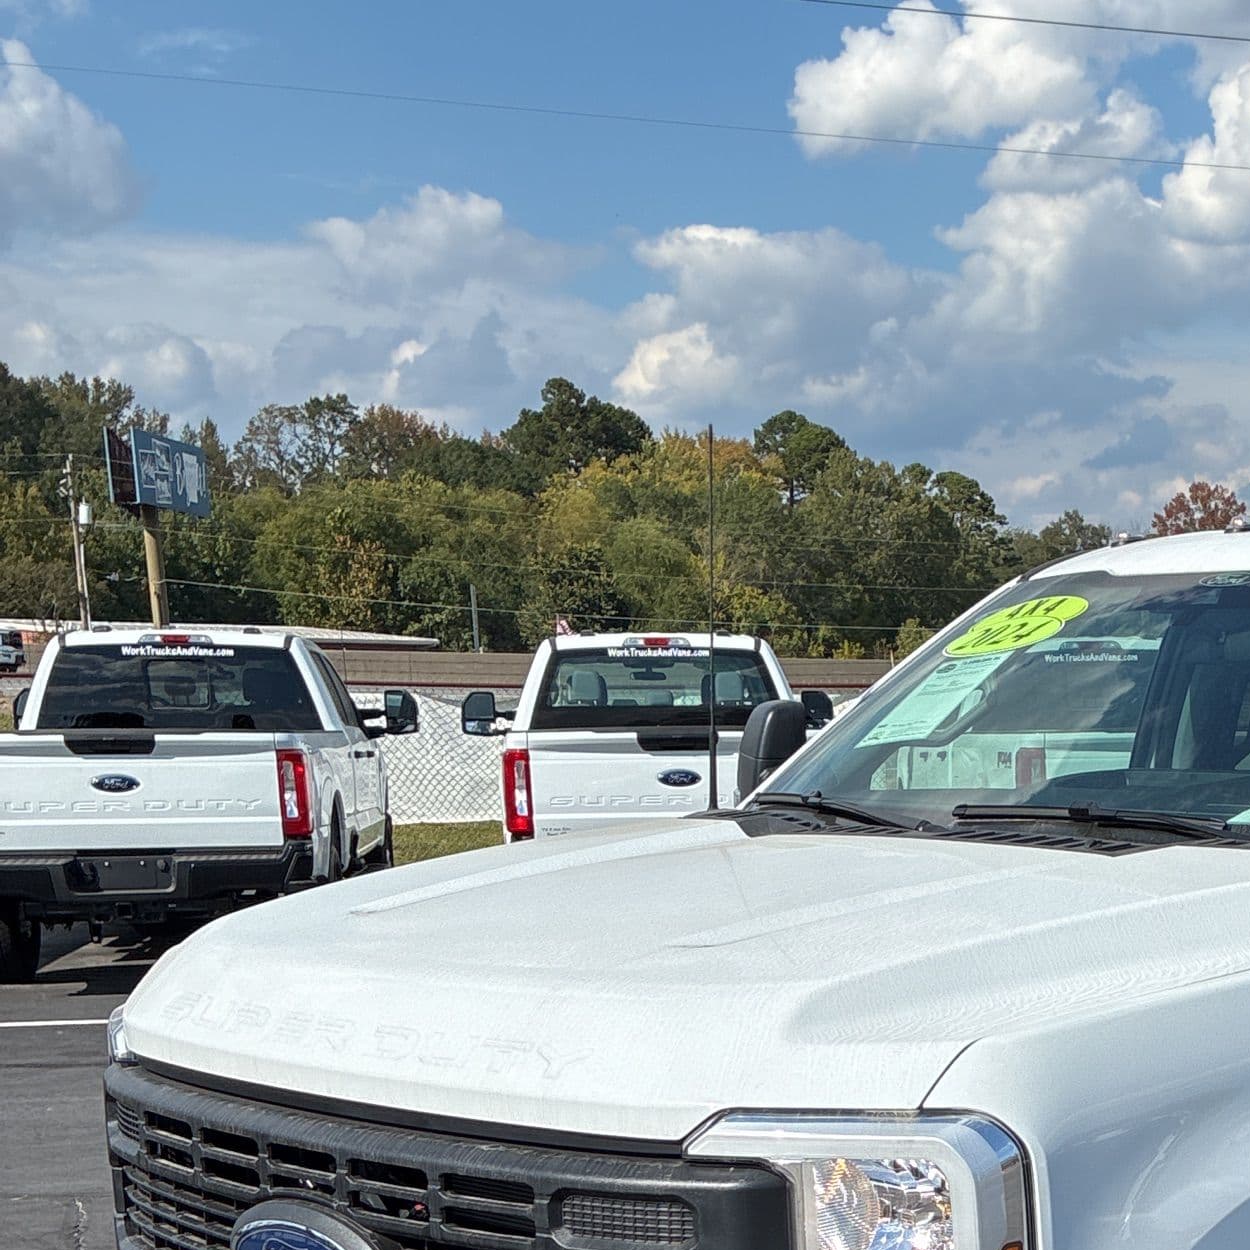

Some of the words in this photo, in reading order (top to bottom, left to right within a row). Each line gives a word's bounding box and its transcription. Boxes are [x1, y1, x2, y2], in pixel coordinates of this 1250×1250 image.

[951, 620, 1055, 651] 2024
[121, 645, 235, 657] WorkTrucksAndVans.com
[607, 647, 710, 658] WorkTrucksAndVans.com
[1044, 652, 1138, 663] WorkTrucksAndVans.com
[1, 800, 133, 813] UPER
[144, 799, 262, 812] DUTY
[549, 794, 693, 808] SUPER
[160, 991, 358, 1053] SUPER
[374, 1023, 596, 1080] DUTY
